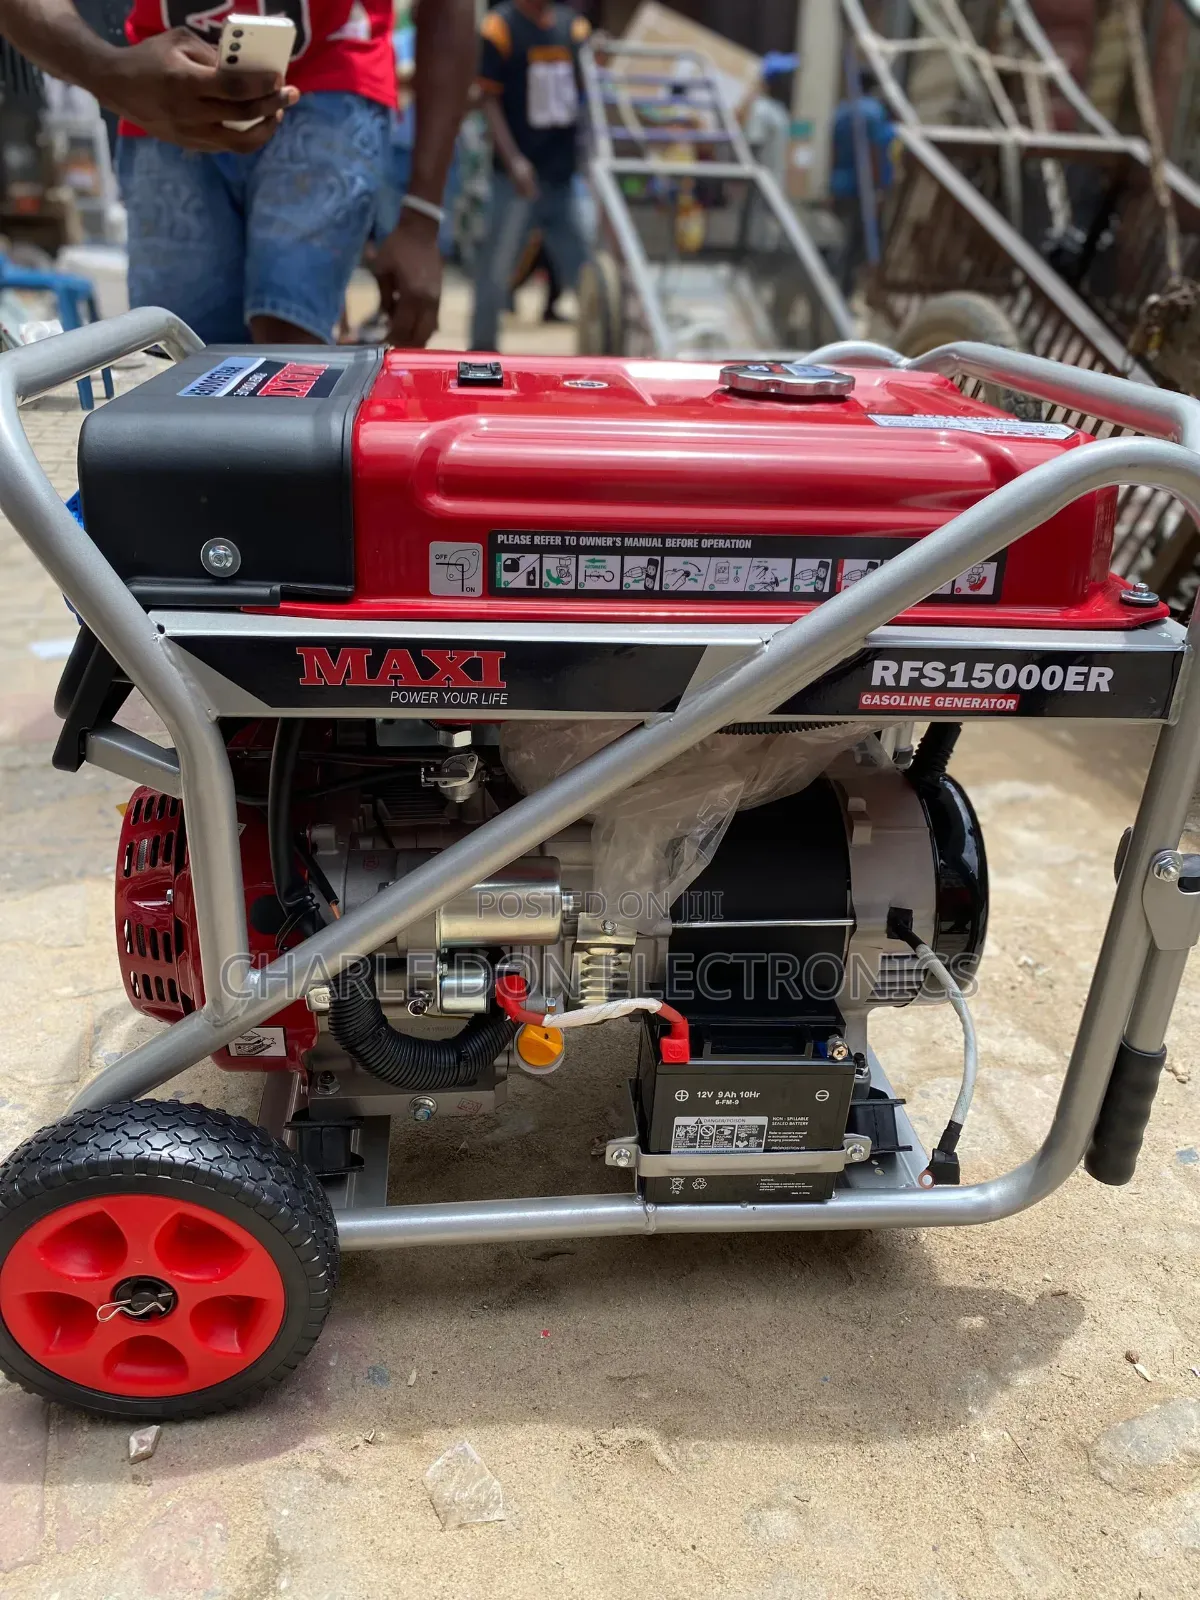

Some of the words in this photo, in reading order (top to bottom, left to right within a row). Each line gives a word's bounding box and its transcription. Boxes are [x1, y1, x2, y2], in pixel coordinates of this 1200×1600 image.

[257, 362, 329, 397] MAXI
[497, 535, 532, 545] PLEASE
[534, 535, 562, 546] REFER
[564, 536, 576, 546] TO
[580, 537, 622, 547] OWNER'S
[624, 538, 663, 548] MANUAL
[665, 538, 699, 548] BEFORE
[701, 538, 752, 549] OPERATION
[296, 647, 506, 688] MAXI
[871, 660, 1114, 692] RFS15000ER
[390, 691, 438, 703] POWER
[443, 692, 478, 704] YOUR
[481, 693, 508, 705] LIFE
[861, 694, 931, 707] GASOLINE
[935, 697, 1016, 710] GENERATOR
